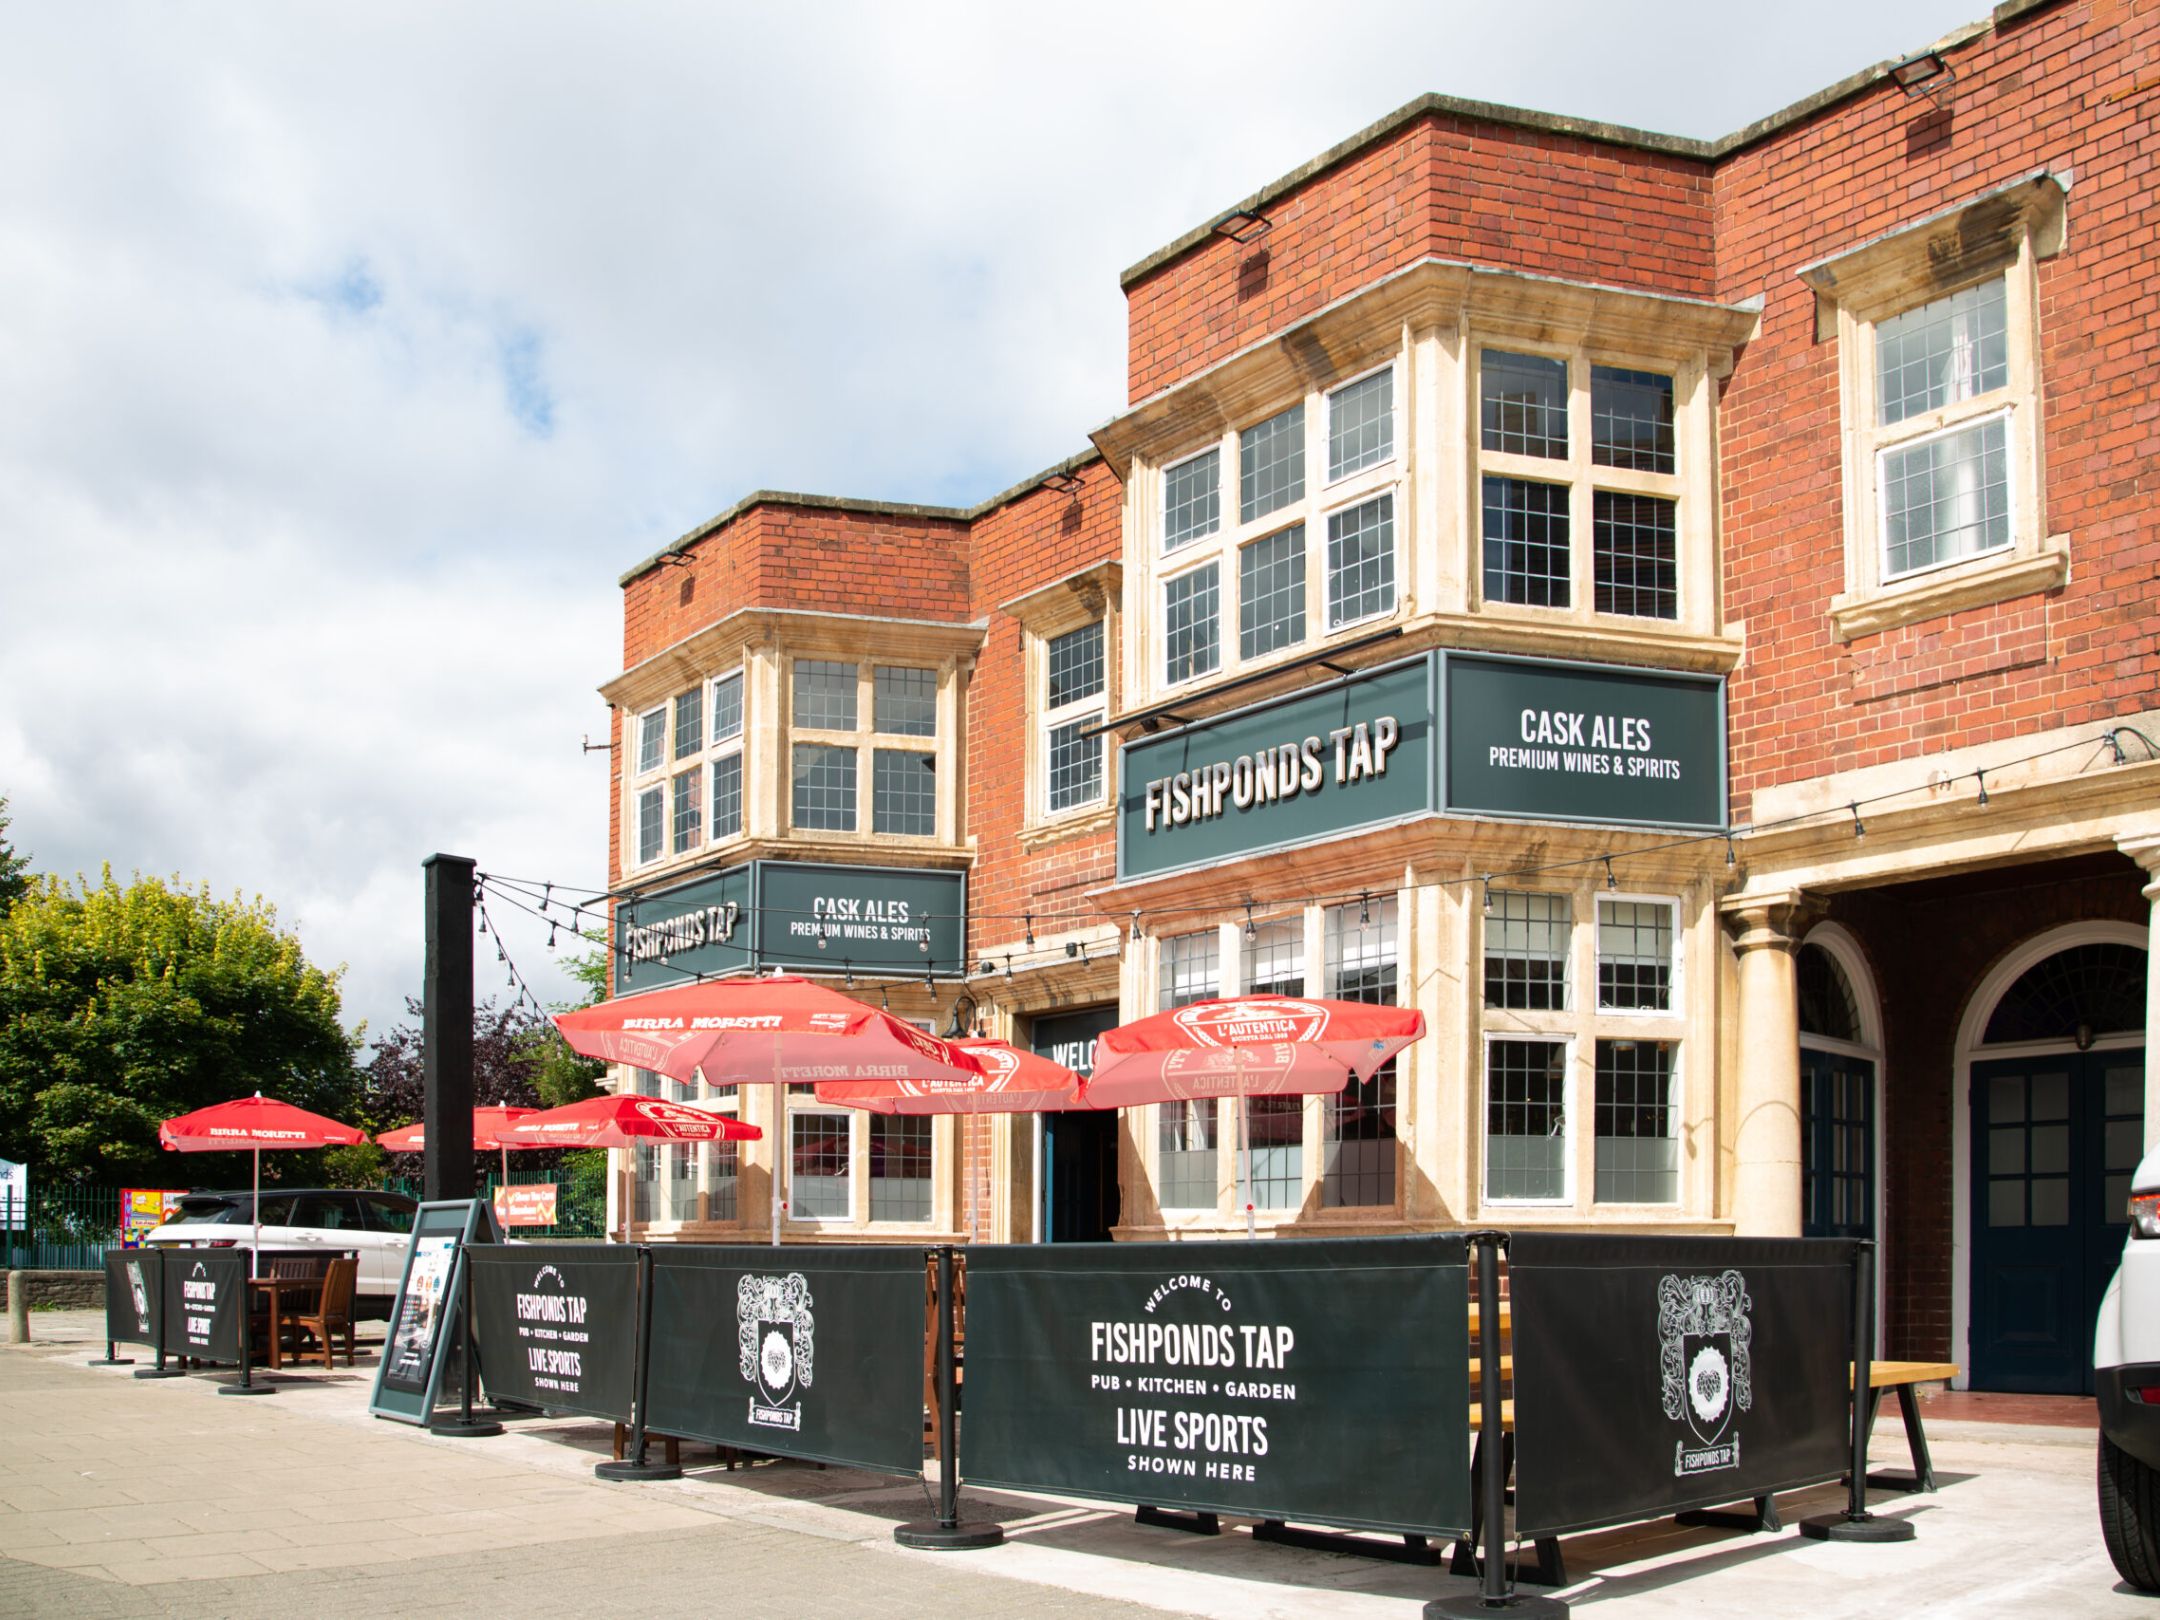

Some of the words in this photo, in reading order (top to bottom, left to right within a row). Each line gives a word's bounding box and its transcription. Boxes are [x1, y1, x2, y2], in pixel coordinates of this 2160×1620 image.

[1521, 709, 1585, 746] CASK
[1591, 715, 1651, 751] ALES
[1145, 736, 1323, 832] FISHPONDS
[1330, 716, 1398, 783] TAP
[1489, 746, 1558, 771] PREMIUM
[1563, 752, 1610, 774] WINES
[1613, 756, 1624, 775] &
[1628, 757, 1680, 780] SPIRITS
[814, 897, 860, 921] CASK
[865, 900, 909, 924] ALES
[625, 910, 705, 963] FISHPONDS
[707, 901, 738, 942] TAP
[791, 922, 840, 937] PREMUM
[844, 925, 878, 939] WINES
[880, 926, 888, 939] &
[891, 927, 930, 941] SPIRITS
[622, 1017, 684, 1030] BIRRA
[691, 1016, 782, 1029] MORETTI
[1217, 1019, 1297, 1037] L'AUTENTICA
[210, 1128, 248, 1137] BIRRA
[251, 1128, 306, 1139] MORETTI
[1144, 1275, 1211, 1313] WELCOME
[1215, 1288, 1232, 1311] TO
[517, 1293, 566, 1322] FISHPONDS
[566, 1296, 587, 1323] TAP
[519, 1327, 529, 1337] PUB
[534, 1328, 558, 1340] KITCHEN
[562, 1331, 589, 1342] GARDEN
[1091, 1322, 1235, 1367] FISHPONDS
[1239, 1325, 1294, 1369] TAP
[528, 1347, 548, 1373] LIVE
[547, 1349, 582, 1377] SPORTS
[535, 1377, 559, 1390] SHOWN
[560, 1381, 579, 1392] HERE
[1091, 1374, 1120, 1390] PUB
[1138, 1377, 1207, 1395] KITCHEN
[1225, 1381, 1296, 1400] GARDEN
[1117, 1407, 1167, 1447] LIVE
[1174, 1411, 1269, 1456] SPORTS
[1128, 1455, 1196, 1476] SHOWN
[1205, 1462, 1256, 1481] HERE
[1685, 1449, 1719, 1469] FISHPONDS
[1720, 1448, 1730, 1463] TAP
